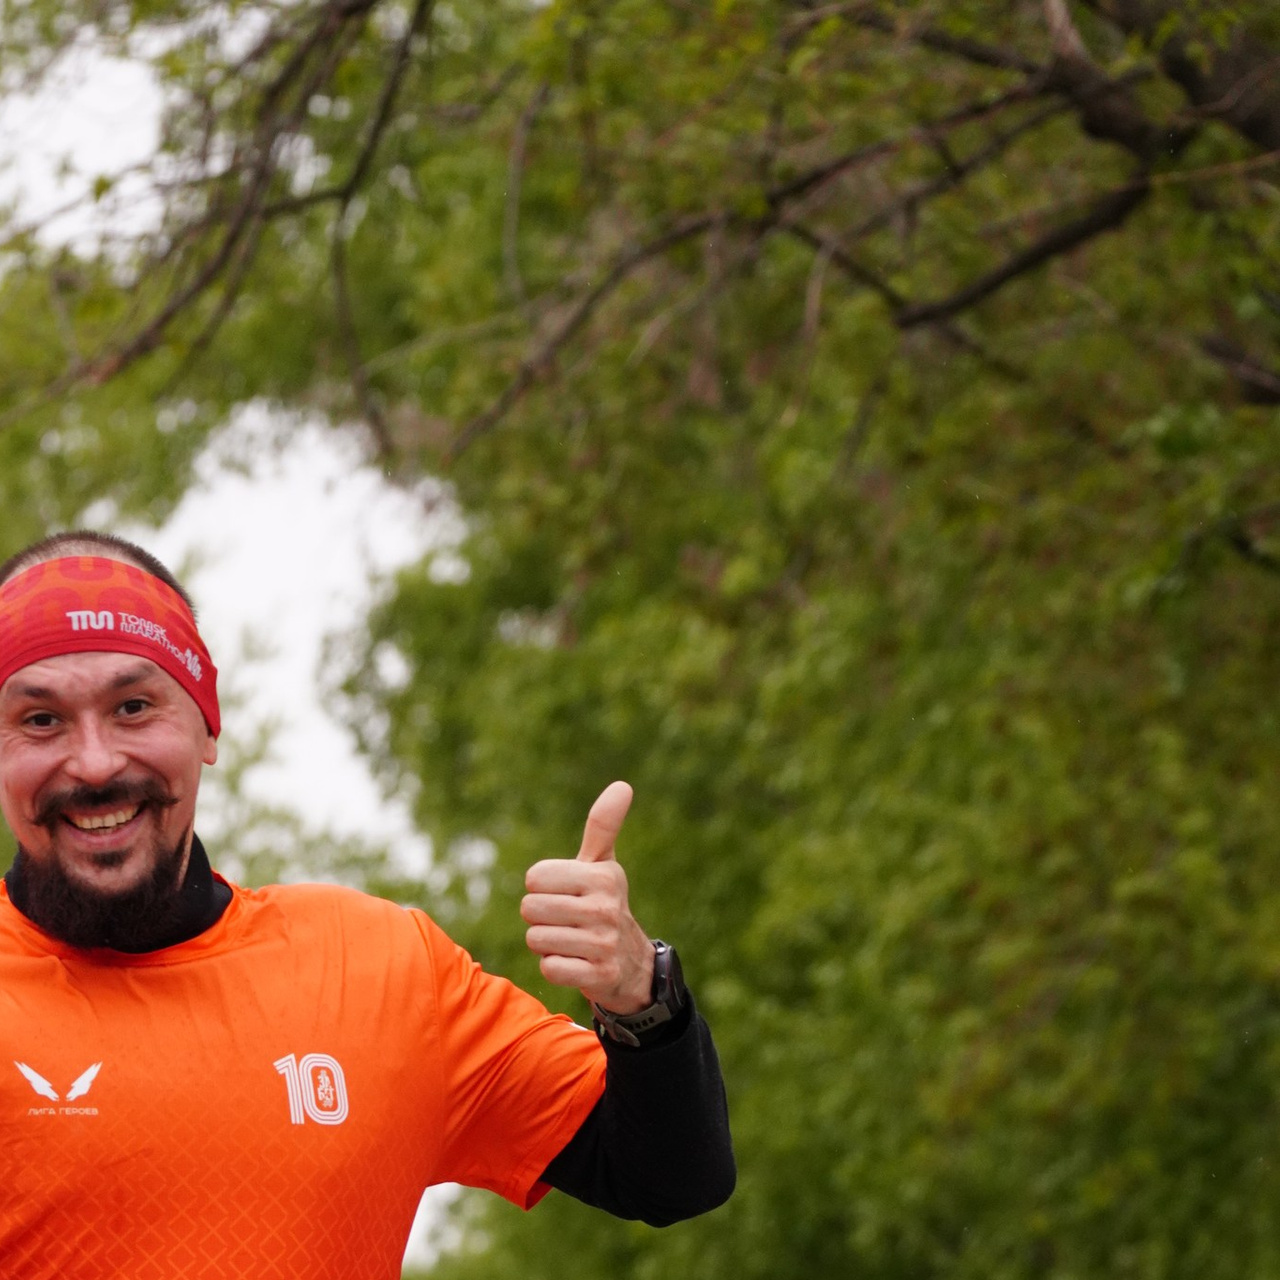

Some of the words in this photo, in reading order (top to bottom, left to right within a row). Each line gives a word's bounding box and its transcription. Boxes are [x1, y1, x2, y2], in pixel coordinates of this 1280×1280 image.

[118, 612, 166, 636] TOMSK
[273, 1053, 349, 1125] 10
[27, 1107, 56, 1116] ЛИГА
[59, 1107, 99, 1116] ГЕРОЕВ
